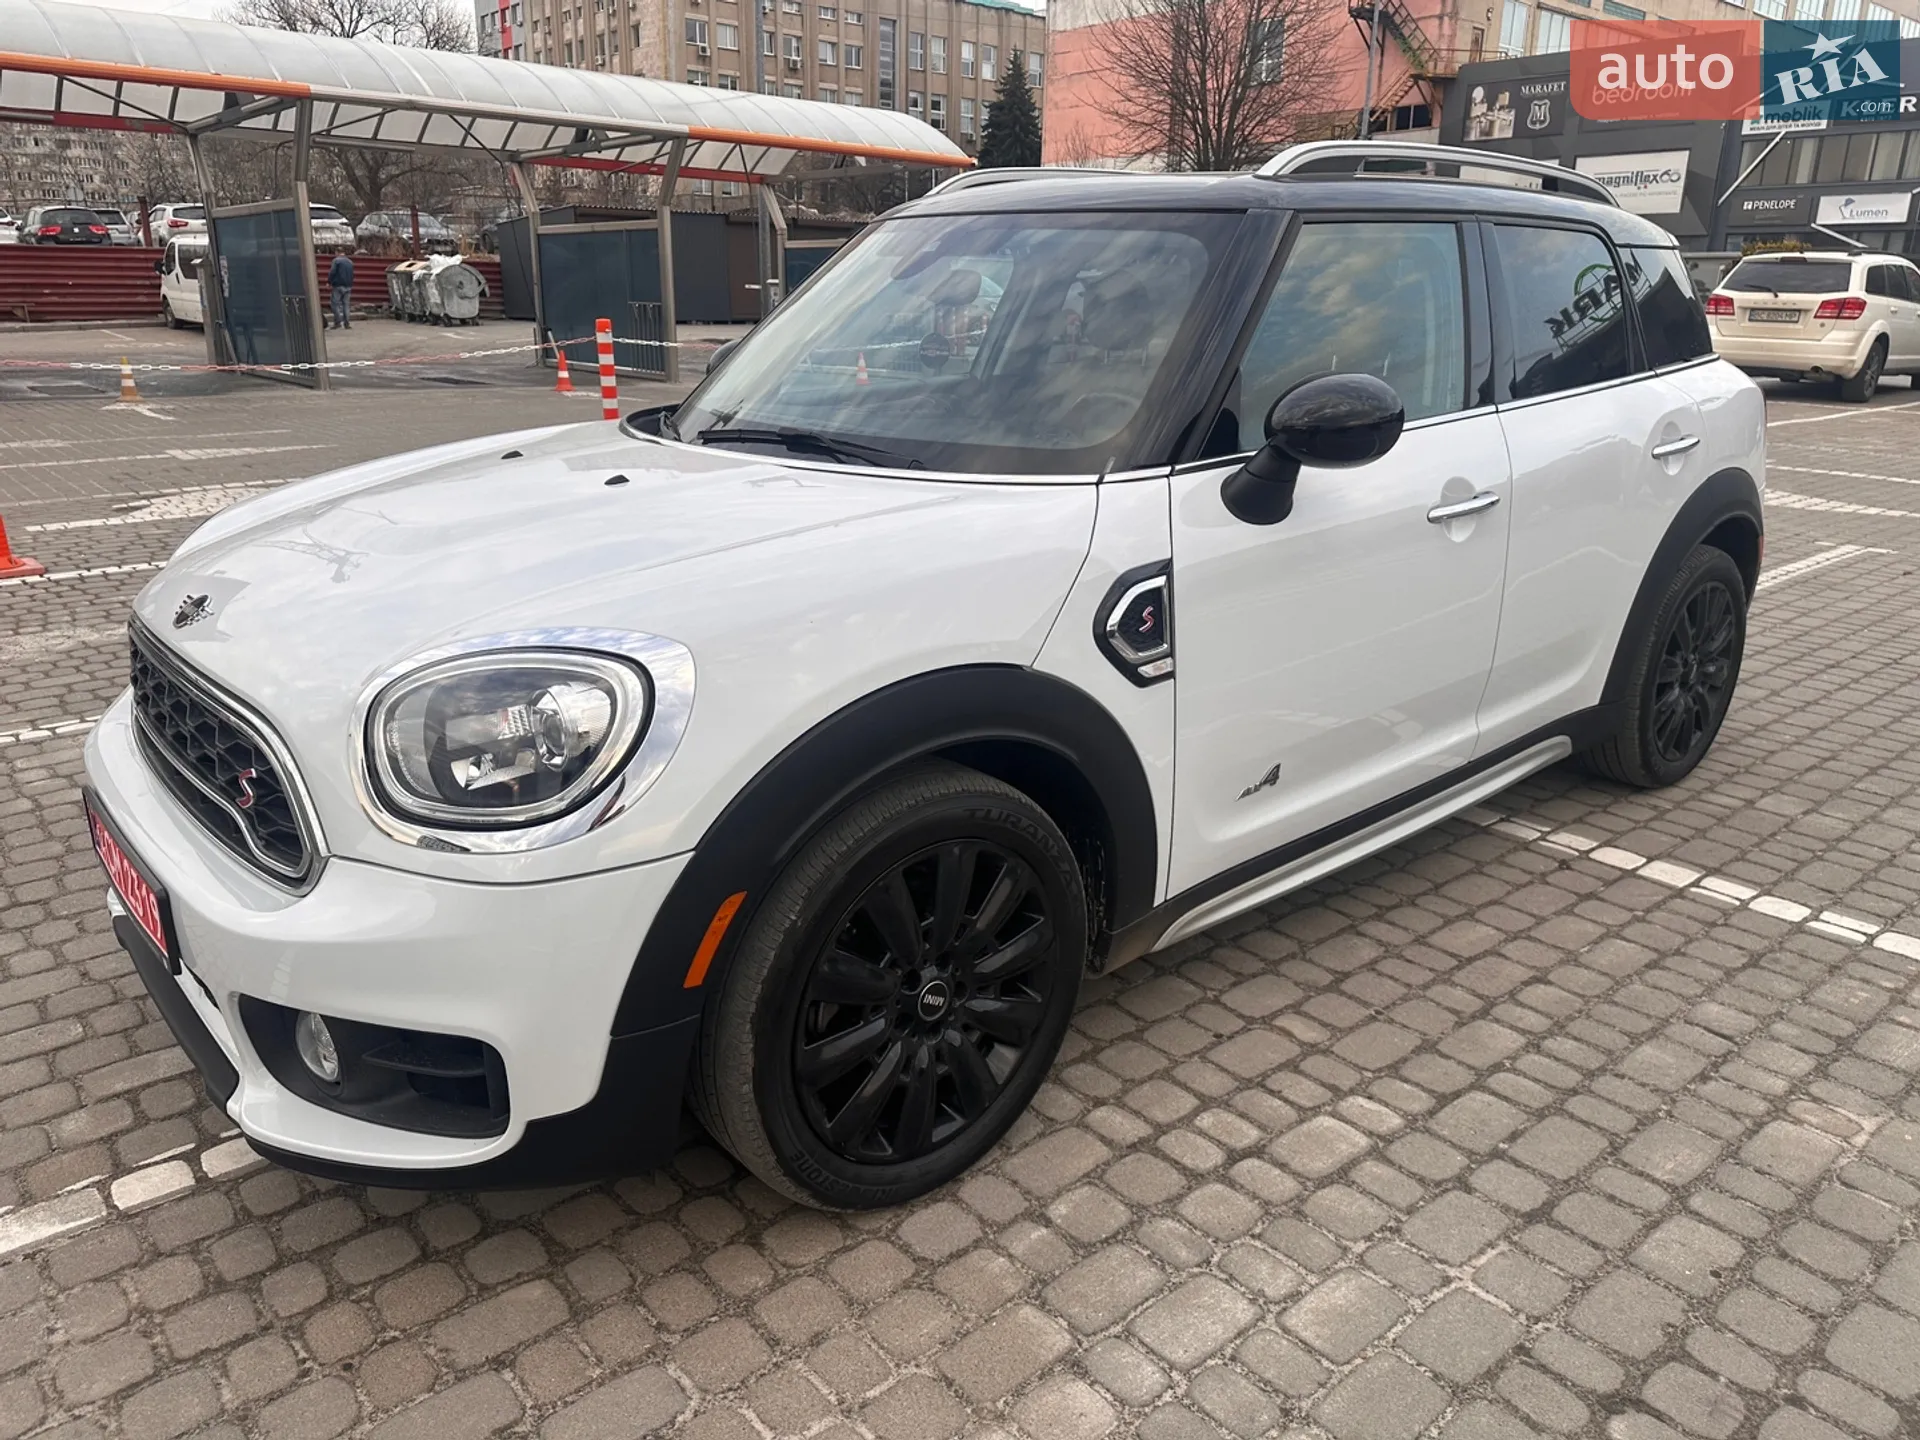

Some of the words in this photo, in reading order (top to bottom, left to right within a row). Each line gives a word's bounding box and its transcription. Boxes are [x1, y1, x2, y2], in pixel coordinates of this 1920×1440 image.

[1520, 81, 1566, 94] MARAFET
[1753, 199, 1796, 210] PENELOPE
[1850, 208, 1888, 218] Lumen
[1139, 606, 1154, 633] S
[236, 768, 257, 808] S
[923, 993, 945, 1006] MINI
